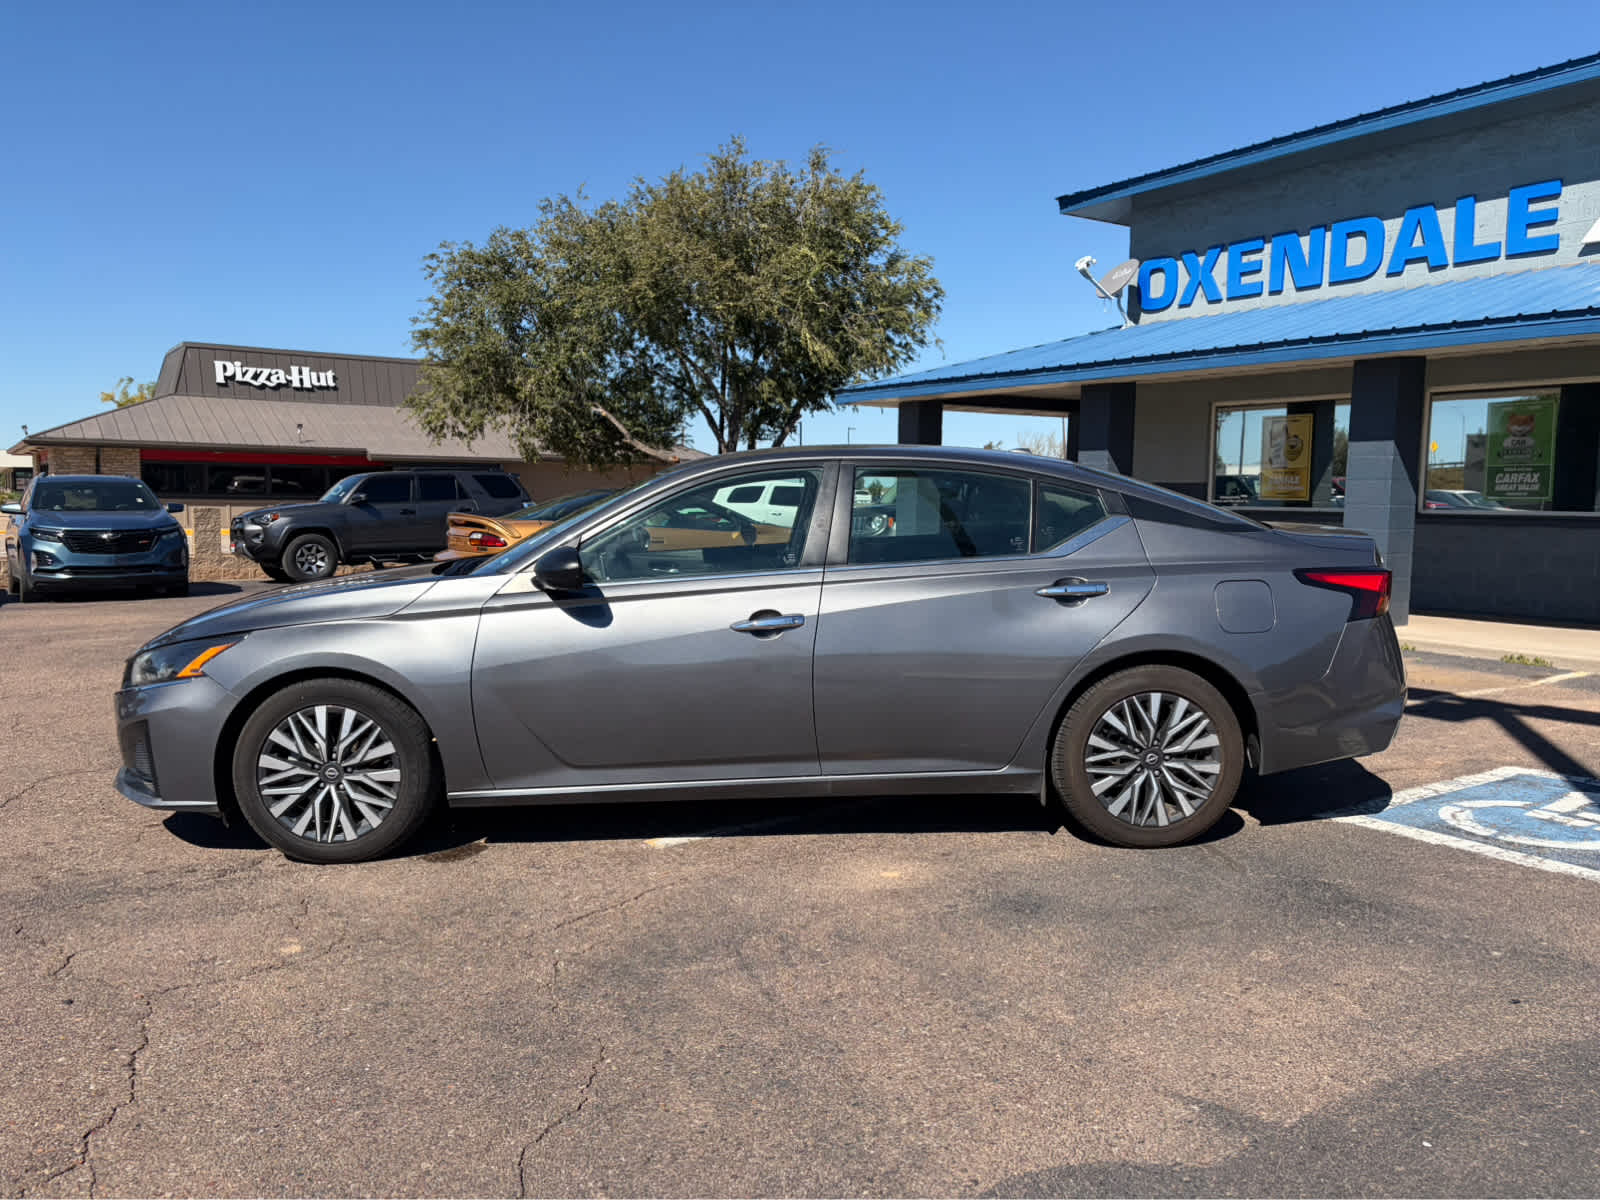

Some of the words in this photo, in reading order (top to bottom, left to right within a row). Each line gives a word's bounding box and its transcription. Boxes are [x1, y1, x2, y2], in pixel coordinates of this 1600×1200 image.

[1138, 179, 1563, 311] OXENDALE
[213, 360, 287, 387] Pizza
[287, 365, 336, 388] Hut
[1495, 472, 1540, 484] CARFAX
